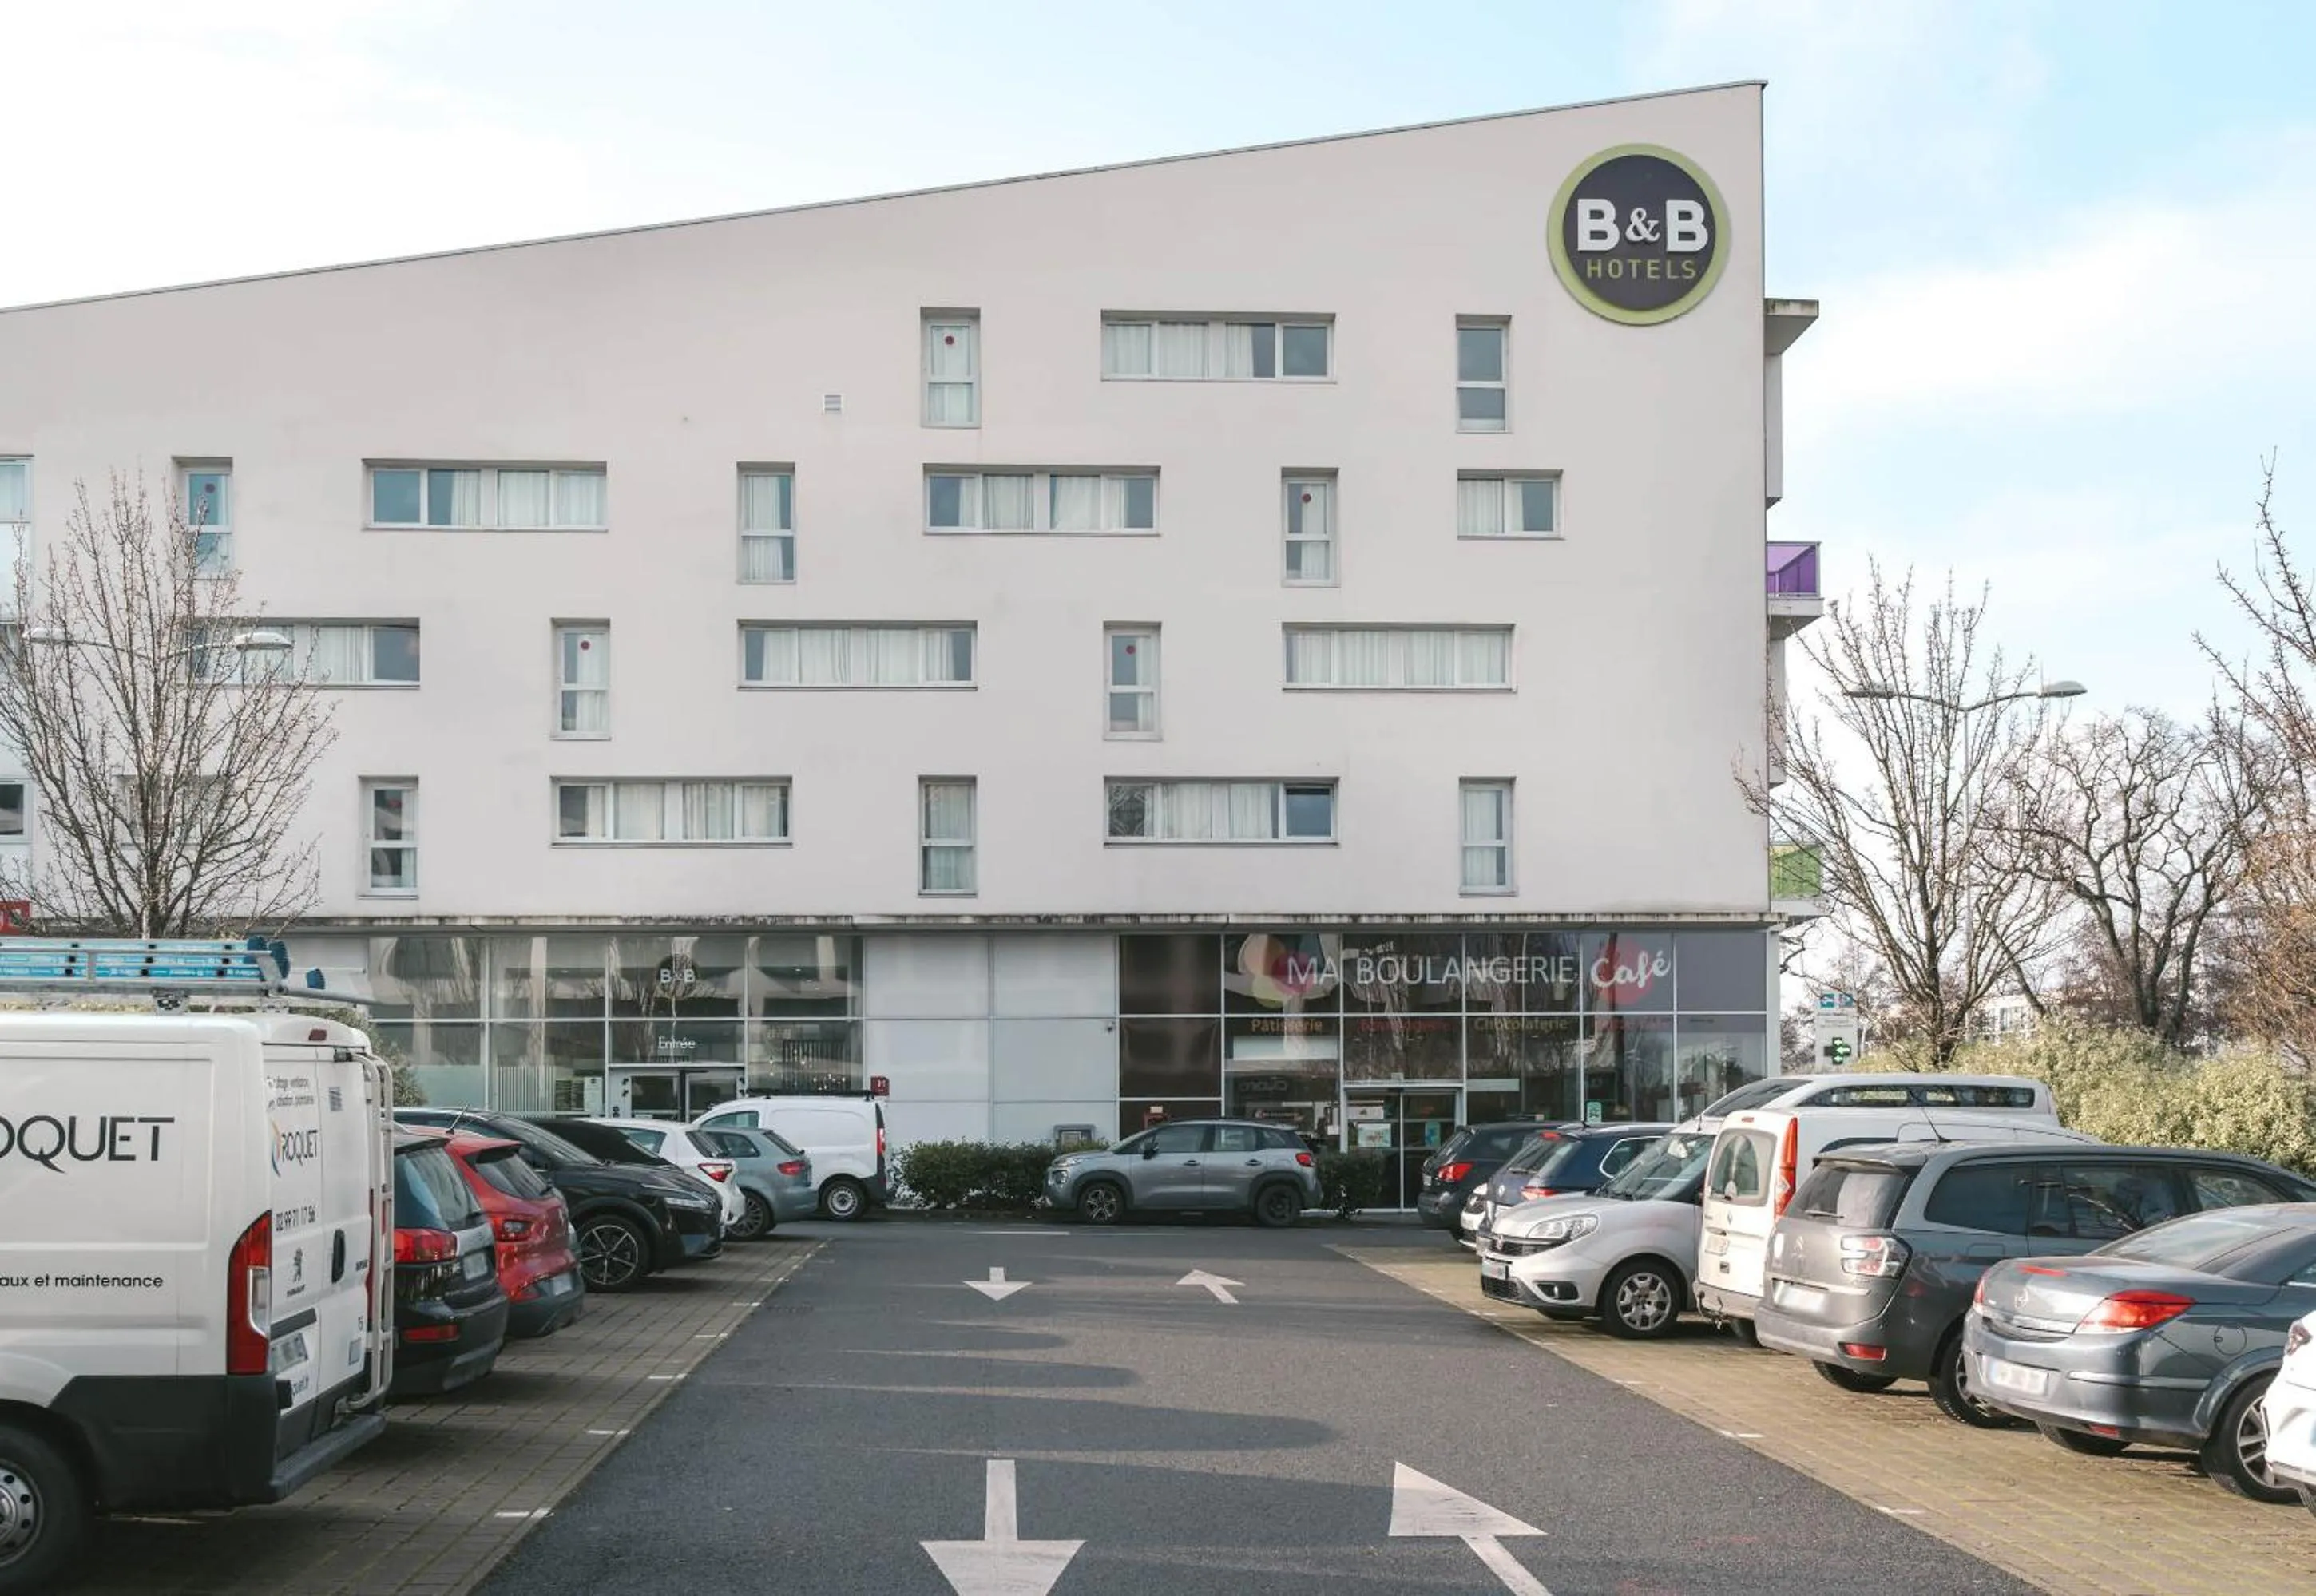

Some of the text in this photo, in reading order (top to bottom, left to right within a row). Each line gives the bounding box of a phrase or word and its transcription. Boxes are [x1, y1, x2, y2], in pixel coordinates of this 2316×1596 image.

[1577, 199, 1709, 252] B&B
[1586, 259, 1697, 280] HOTELS
[1287, 950, 1671, 988] MA BOULANGERIE Café
[658, 1036, 696, 1049] Entrée
[281, 1129, 318, 1166] ROQUET
[34, 1274, 50, 1287] et
[54, 1274, 164, 1288] maintenance
